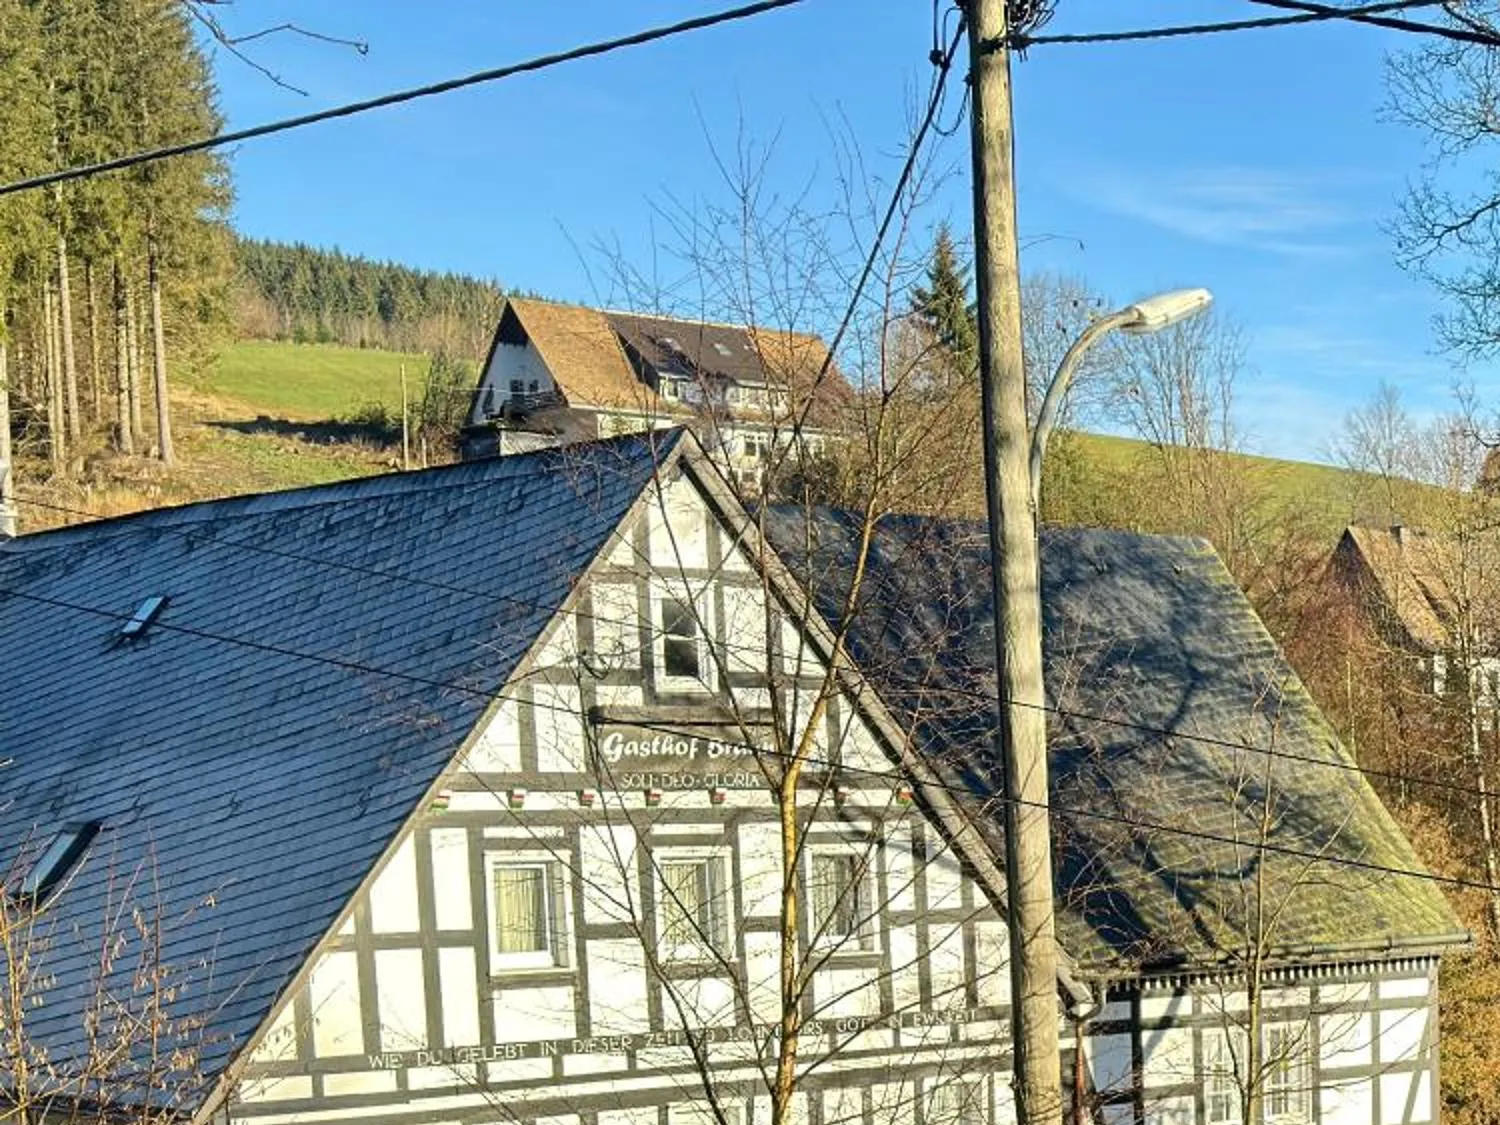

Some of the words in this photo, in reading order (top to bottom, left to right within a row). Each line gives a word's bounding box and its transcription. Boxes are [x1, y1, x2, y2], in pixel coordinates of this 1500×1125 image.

[602, 733, 699, 763] Gasthof
[369, 1053, 403, 1069] WIE
[540, 1040, 558, 1057] IN
[572, 1034, 633, 1054] DIESER
